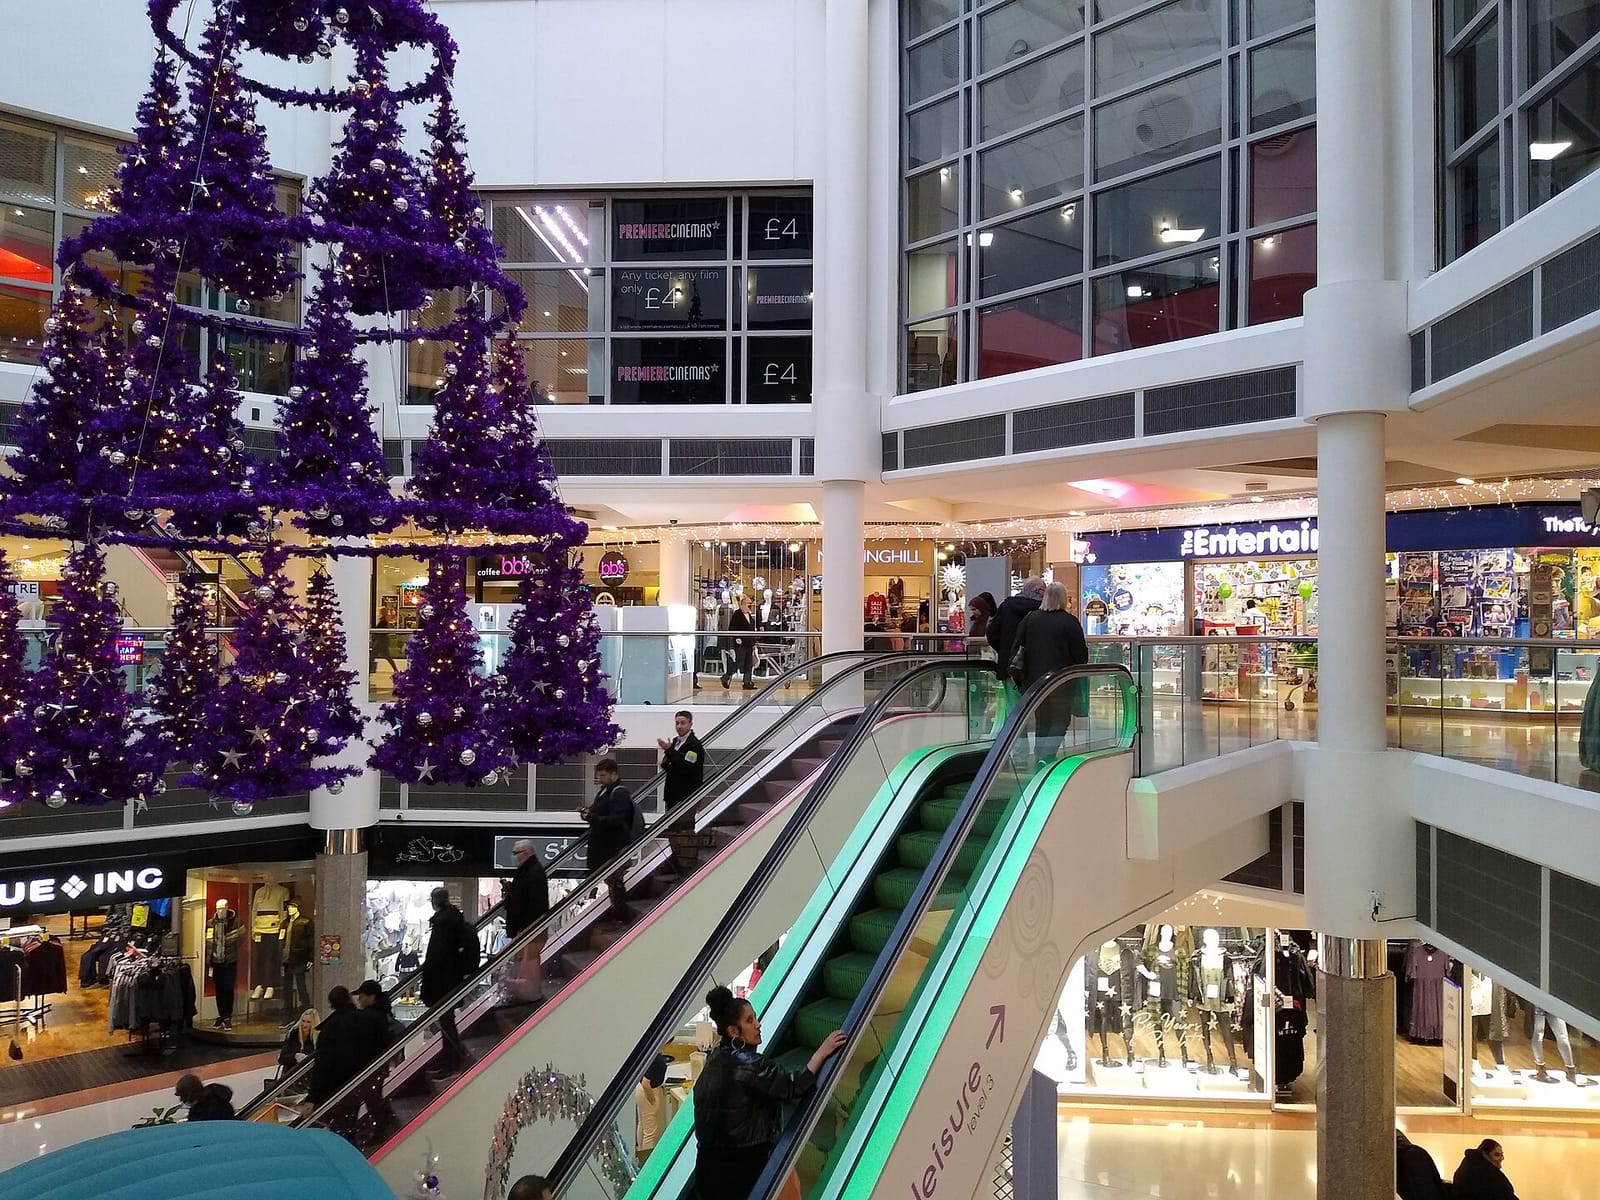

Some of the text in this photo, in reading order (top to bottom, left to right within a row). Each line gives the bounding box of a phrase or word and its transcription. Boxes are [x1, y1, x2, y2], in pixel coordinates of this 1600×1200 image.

[764, 217, 799, 240] £4
[621, 271, 641, 281] Any
[679, 272, 697, 281] any
[700, 271, 719, 279] film
[621, 284, 679, 309] only £4
[763, 362, 798, 385] £4
[477, 567, 501, 576] coffee
[93, 867, 164, 895] INC
[967, 1073, 994, 1135] level 3
[911, 1062, 982, 1200] leisure
